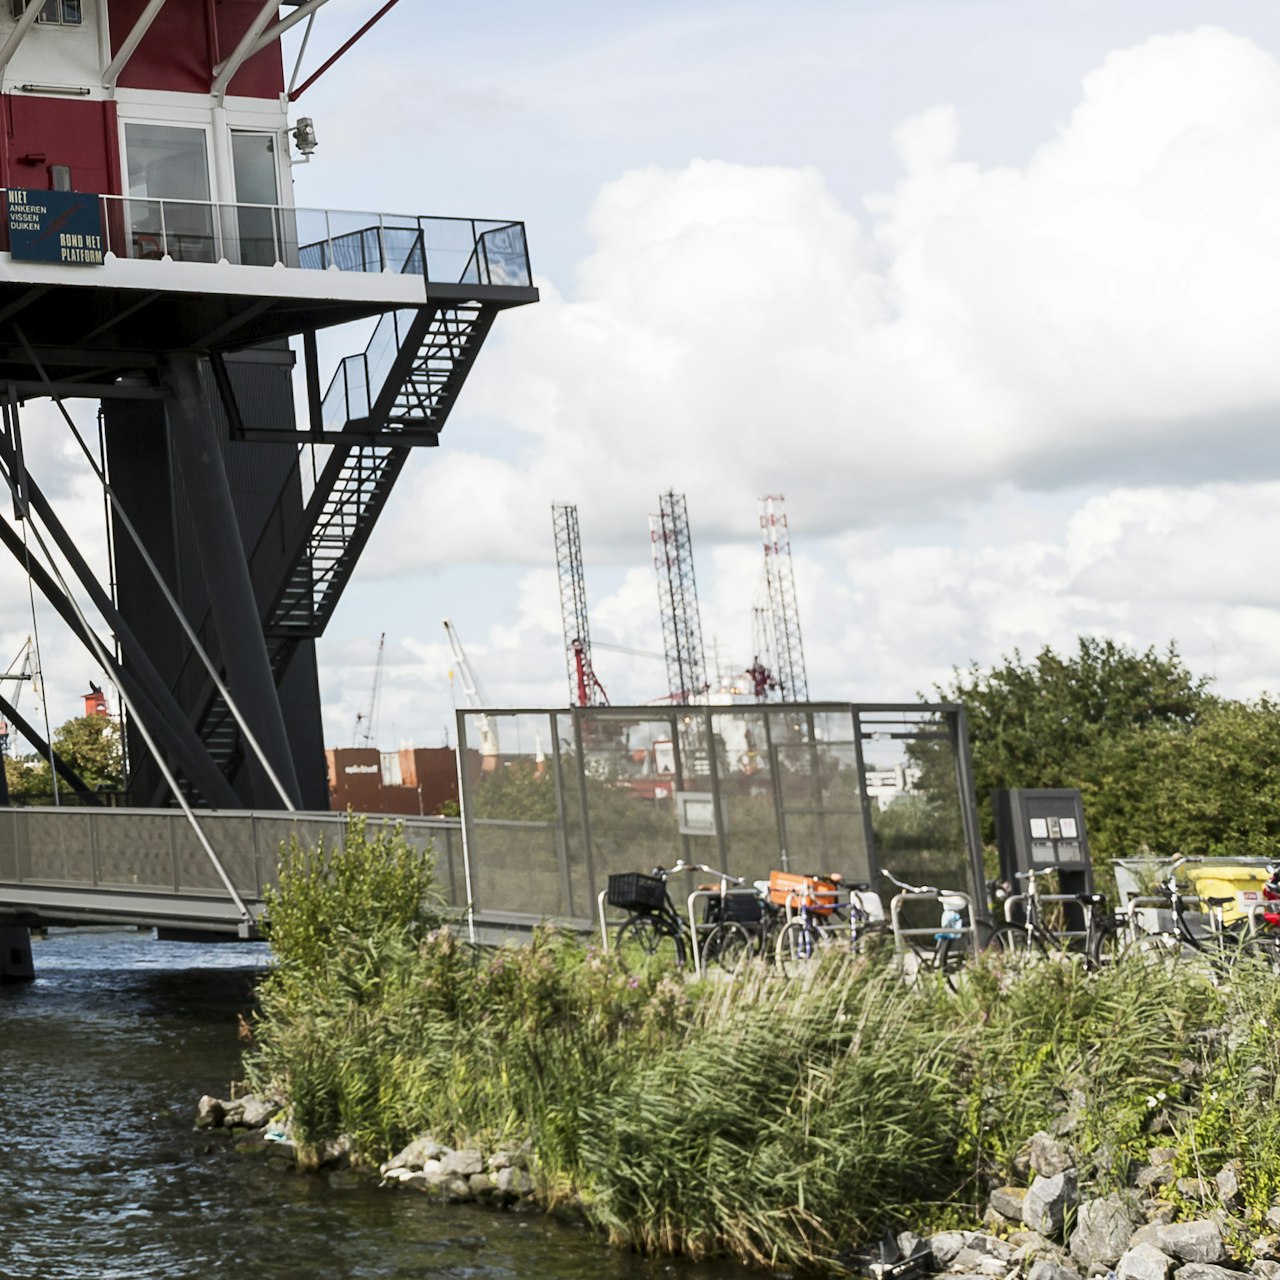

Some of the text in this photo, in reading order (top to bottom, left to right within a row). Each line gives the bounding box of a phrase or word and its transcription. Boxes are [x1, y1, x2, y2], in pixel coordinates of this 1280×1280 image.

[8, 190, 27, 203] NIET
[9, 205, 47, 214] ANKEREN
[10, 213, 39, 222] VISSEN
[10, 222, 40, 230] DUIKEN
[60, 233, 101, 249] ROND HET
[61, 248, 103, 263] PLATFORM
